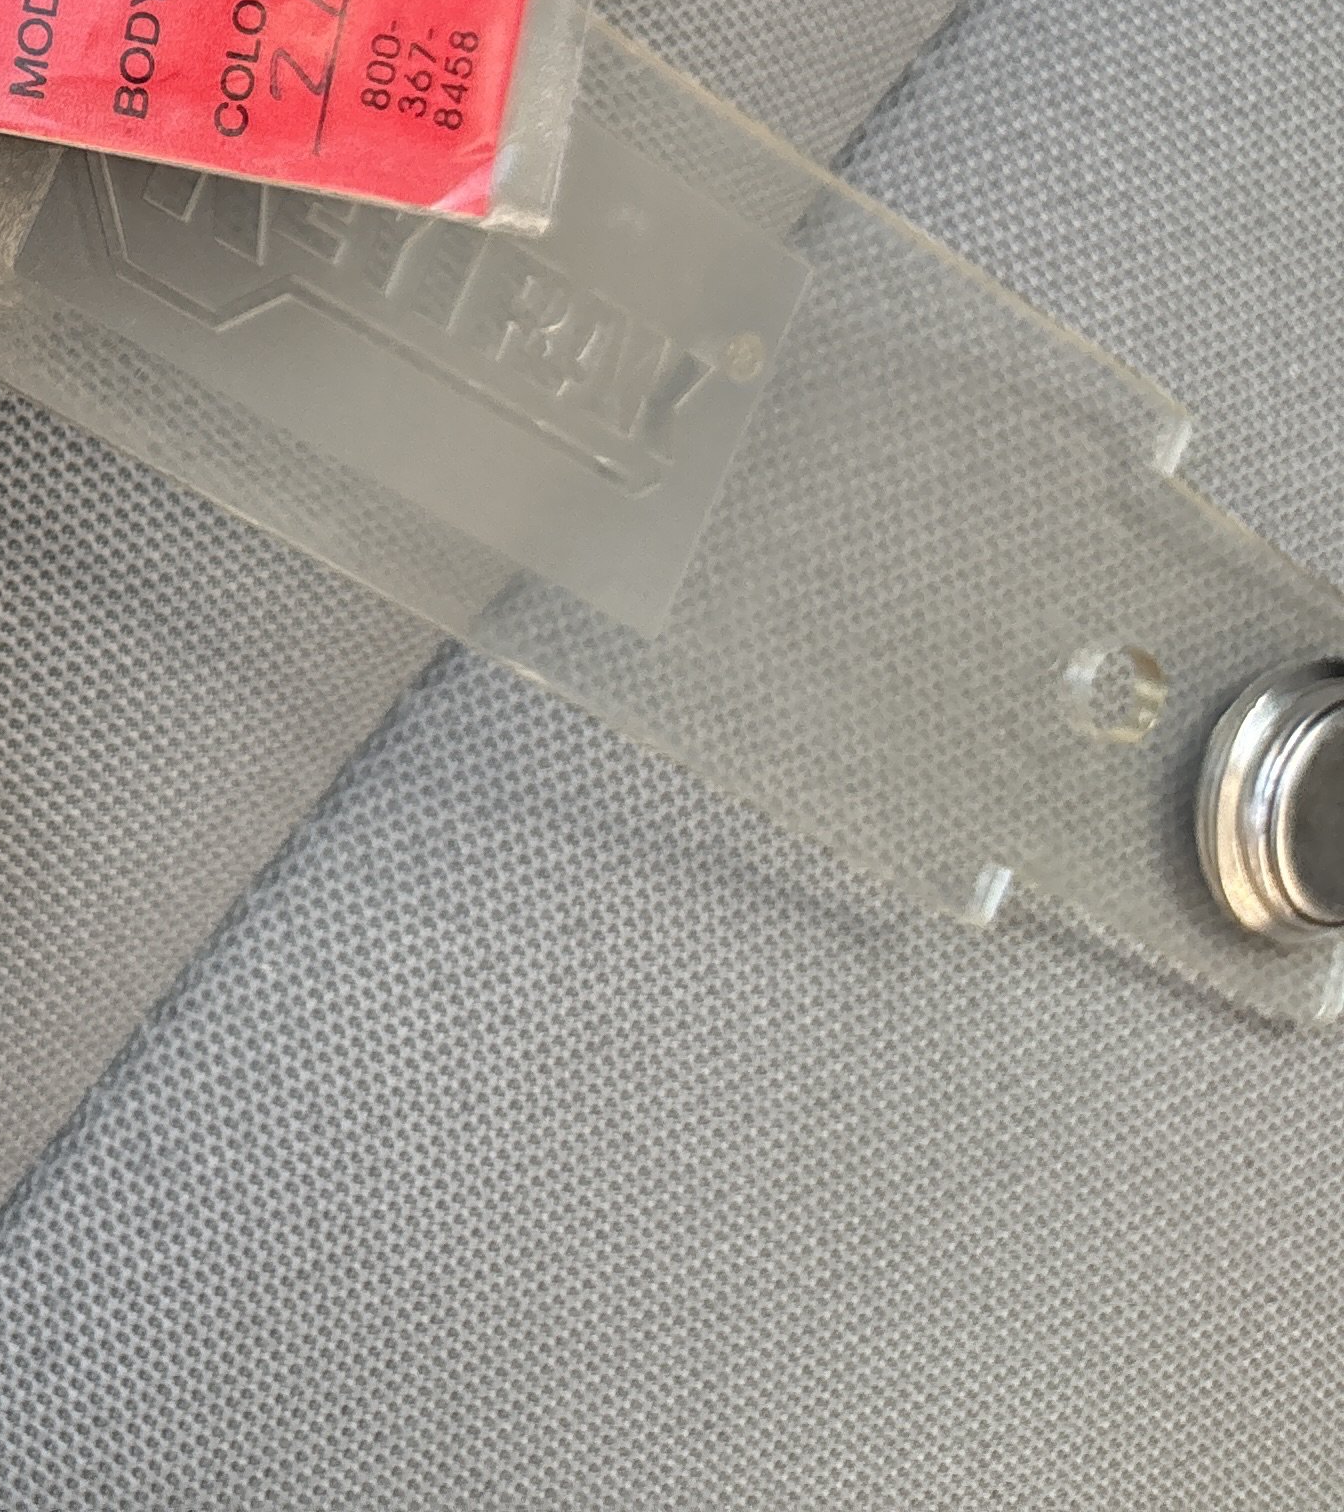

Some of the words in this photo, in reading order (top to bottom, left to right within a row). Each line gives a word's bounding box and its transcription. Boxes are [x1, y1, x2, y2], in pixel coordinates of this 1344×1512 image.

[361, 20, 404, 111] 800-
[398, 31, 438, 119] 367-
[436, 29, 480, 131] 8458
